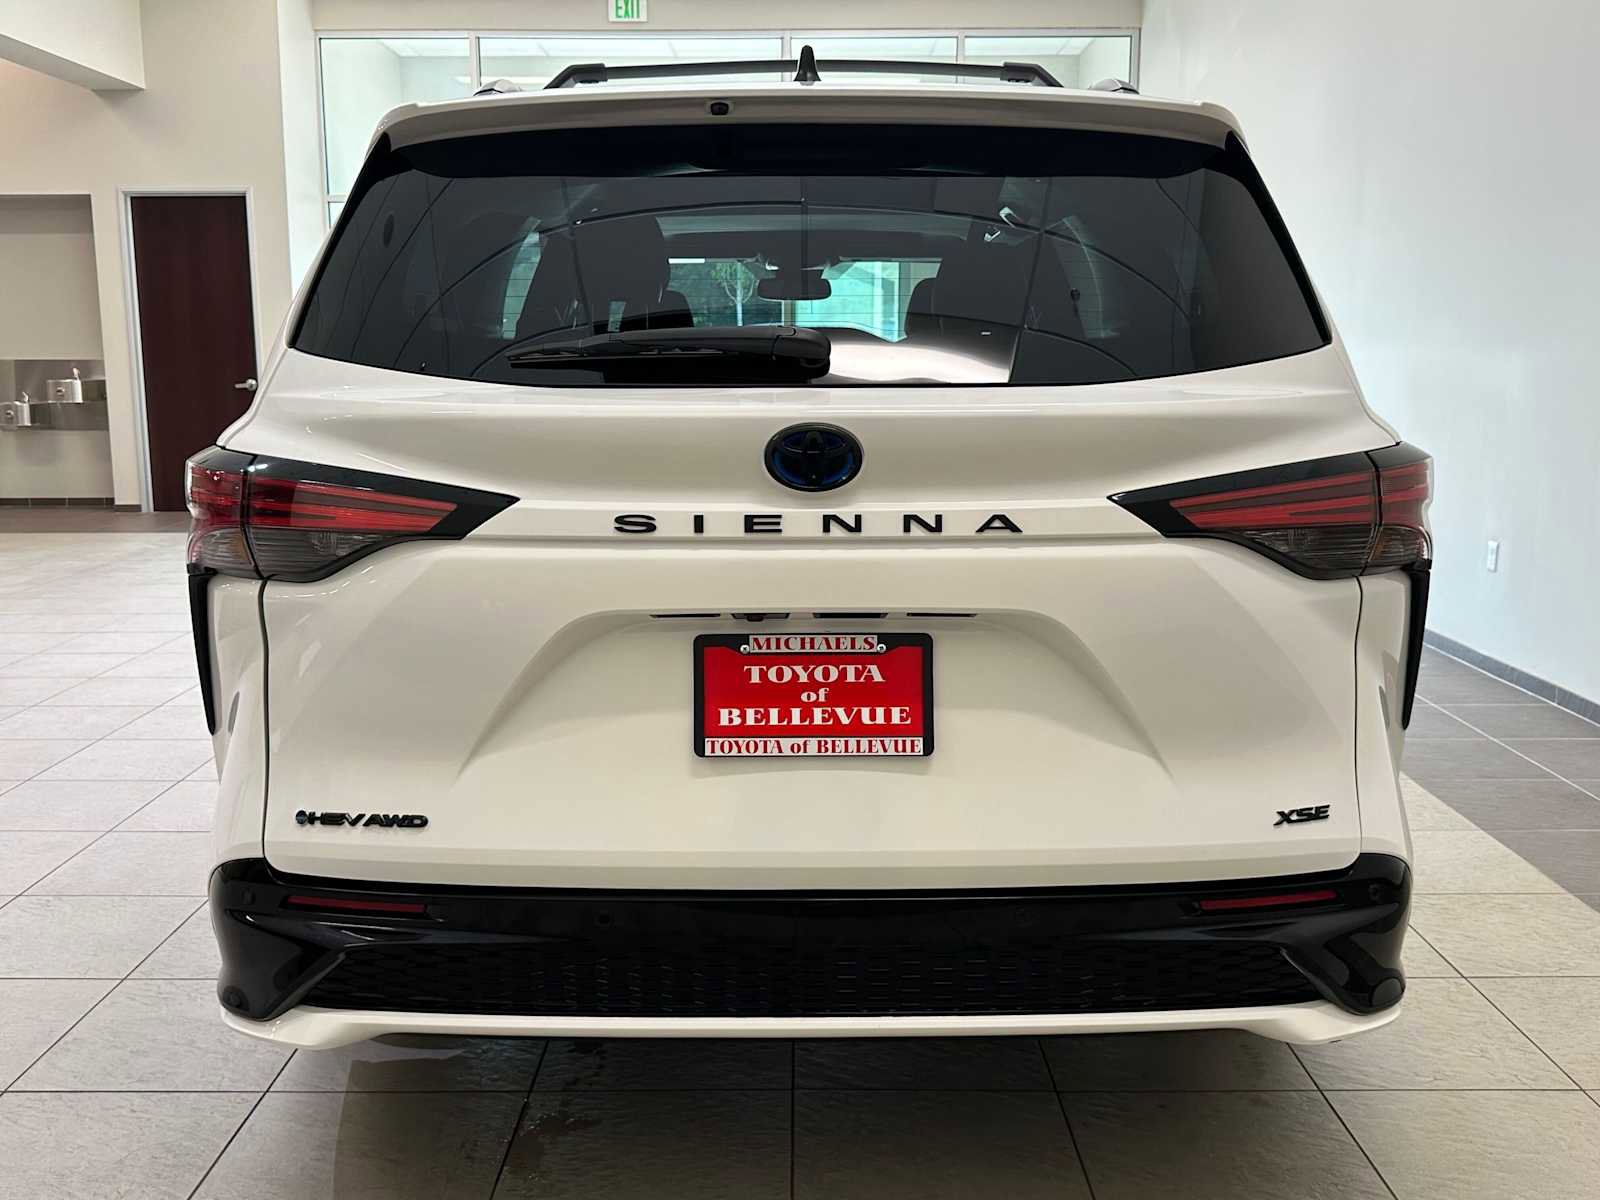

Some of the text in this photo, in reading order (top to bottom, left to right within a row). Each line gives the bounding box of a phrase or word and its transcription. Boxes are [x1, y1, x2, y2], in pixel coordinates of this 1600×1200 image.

[614, 514, 1023, 534] SIENNA
[752, 637, 875, 650] MICHAELS
[744, 665, 885, 683] TOYOTA
[801, 688, 829, 702] of
[718, 707, 911, 726] BELLEVUE
[706, 739, 921, 754] TOYOTA of BELLEVUE
[1273, 804, 1331, 826] XSE
